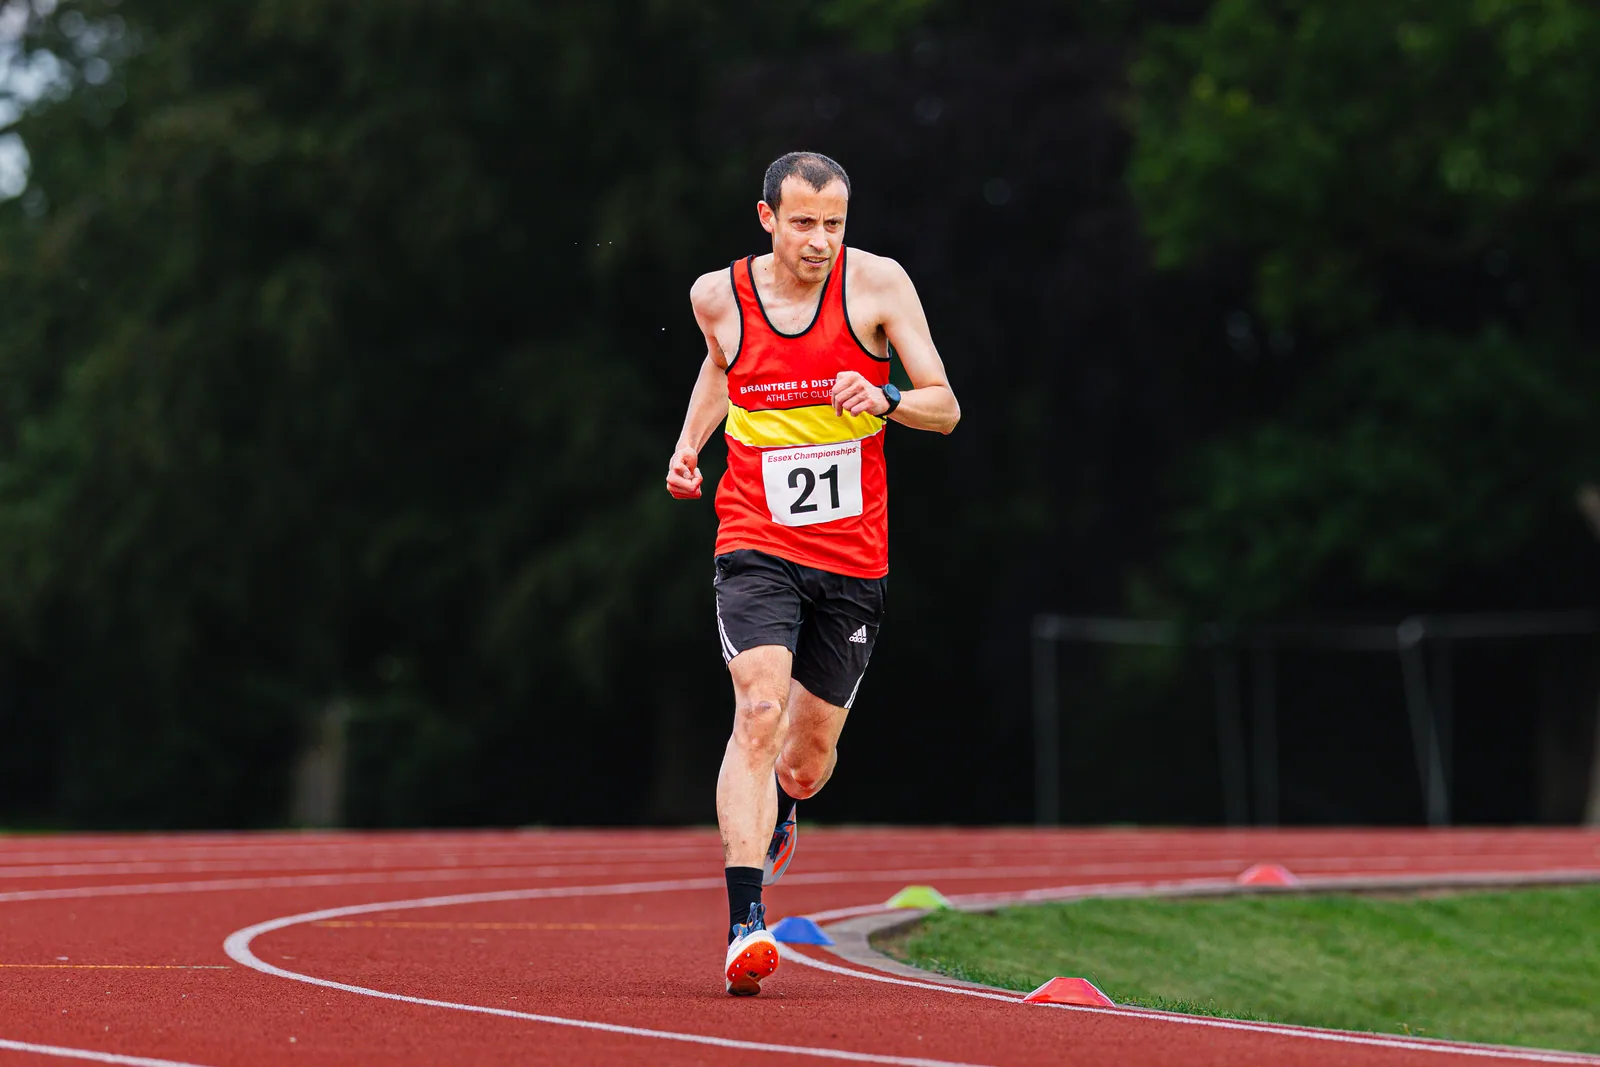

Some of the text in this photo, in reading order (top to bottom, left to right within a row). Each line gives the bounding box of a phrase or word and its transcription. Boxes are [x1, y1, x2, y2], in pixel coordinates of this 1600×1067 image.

[740, 378, 838, 394] BRAINTREE & DIST
[766, 391, 809, 402] ATHLETIC
[767, 446, 857, 463] Essex Championships
[787, 464, 840, 514] 21
